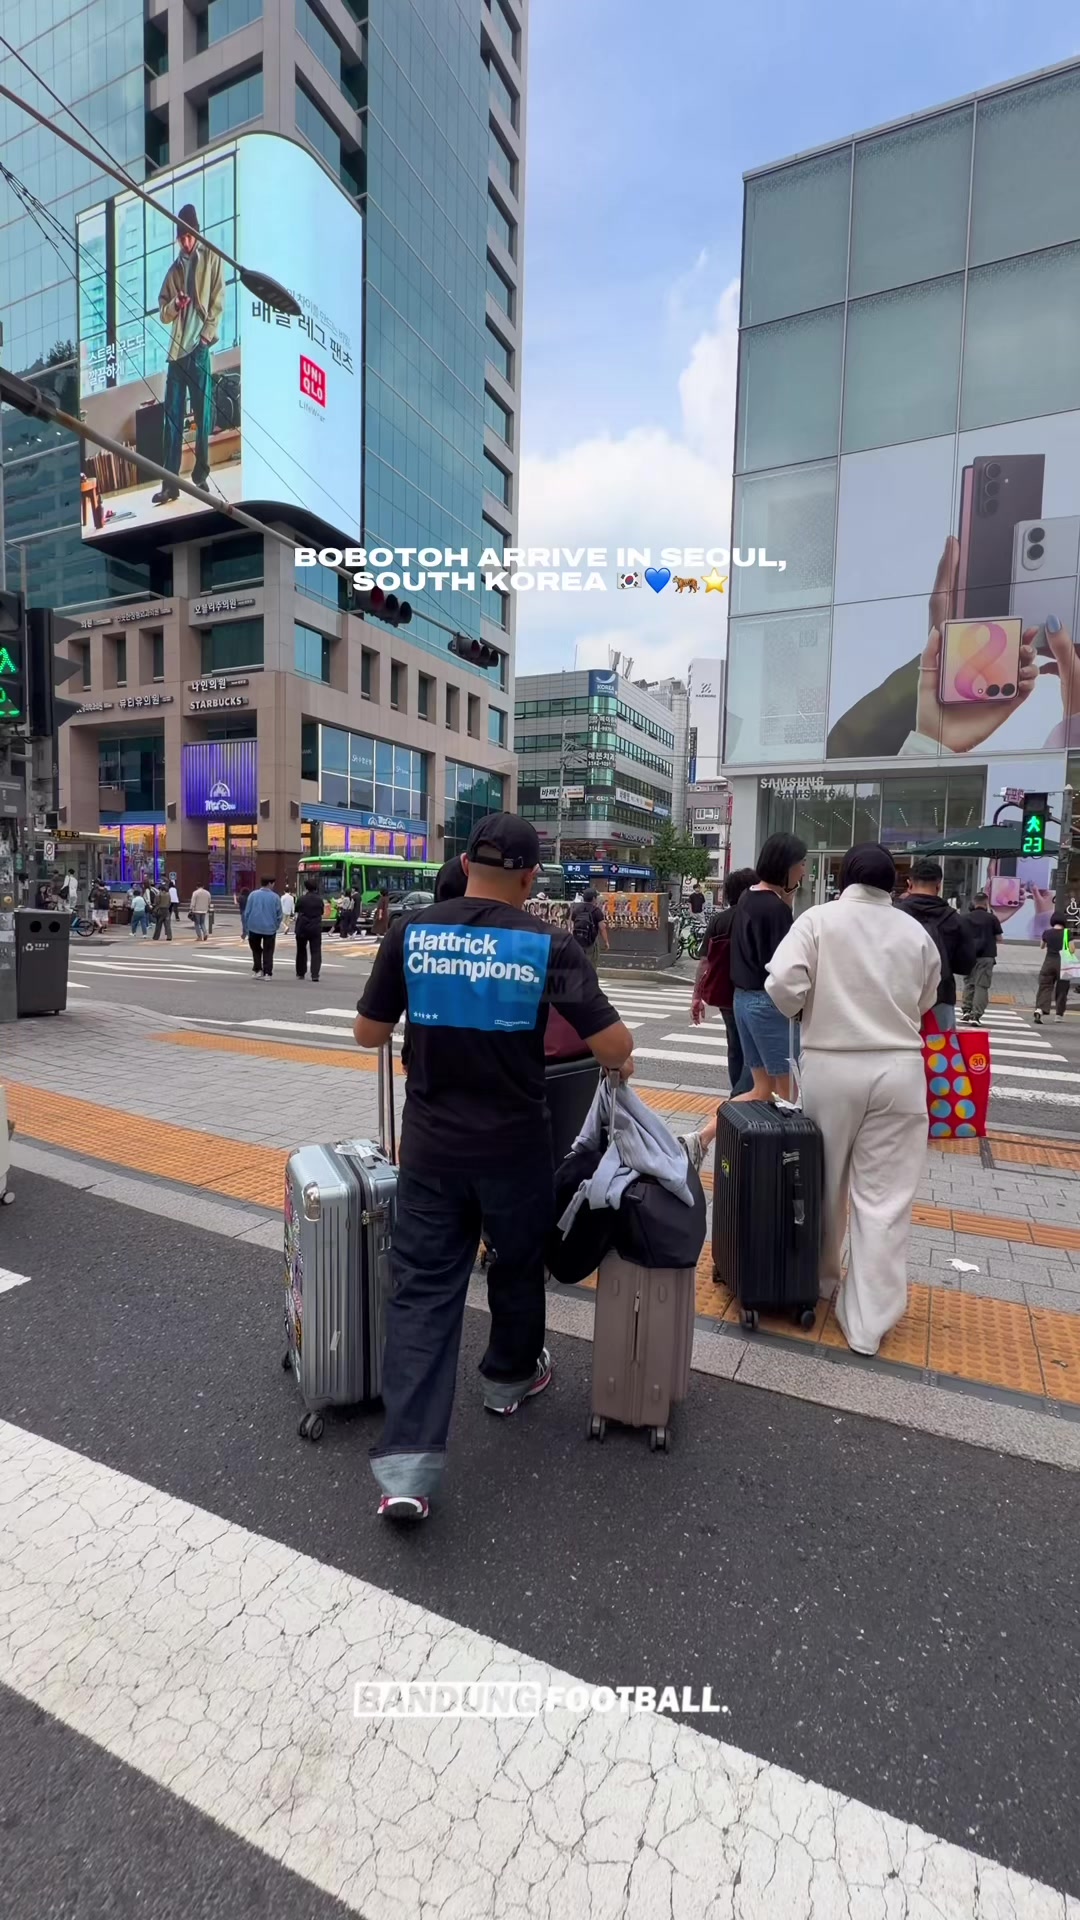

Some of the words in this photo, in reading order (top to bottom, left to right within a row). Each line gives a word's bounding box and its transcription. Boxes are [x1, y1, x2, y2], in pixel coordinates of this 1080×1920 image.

[88, 343, 116, 366] 스트릿
[298, 314, 327, 351] 레그
[330, 337, 354, 375] 팬츠
[303, 361, 322, 386] UNI
[303, 377, 323, 401] QLO
[191, 678, 226, 692] 나인의원
[190, 697, 242, 710] STARBUCKS
[760, 776, 825, 789] SAMSUNG
[1023, 837, 1042, 853] 23
[408, 930, 498, 955] Hattrick
[407, 951, 540, 983] Champions.
[972, 1057, 984, 1067] 30
